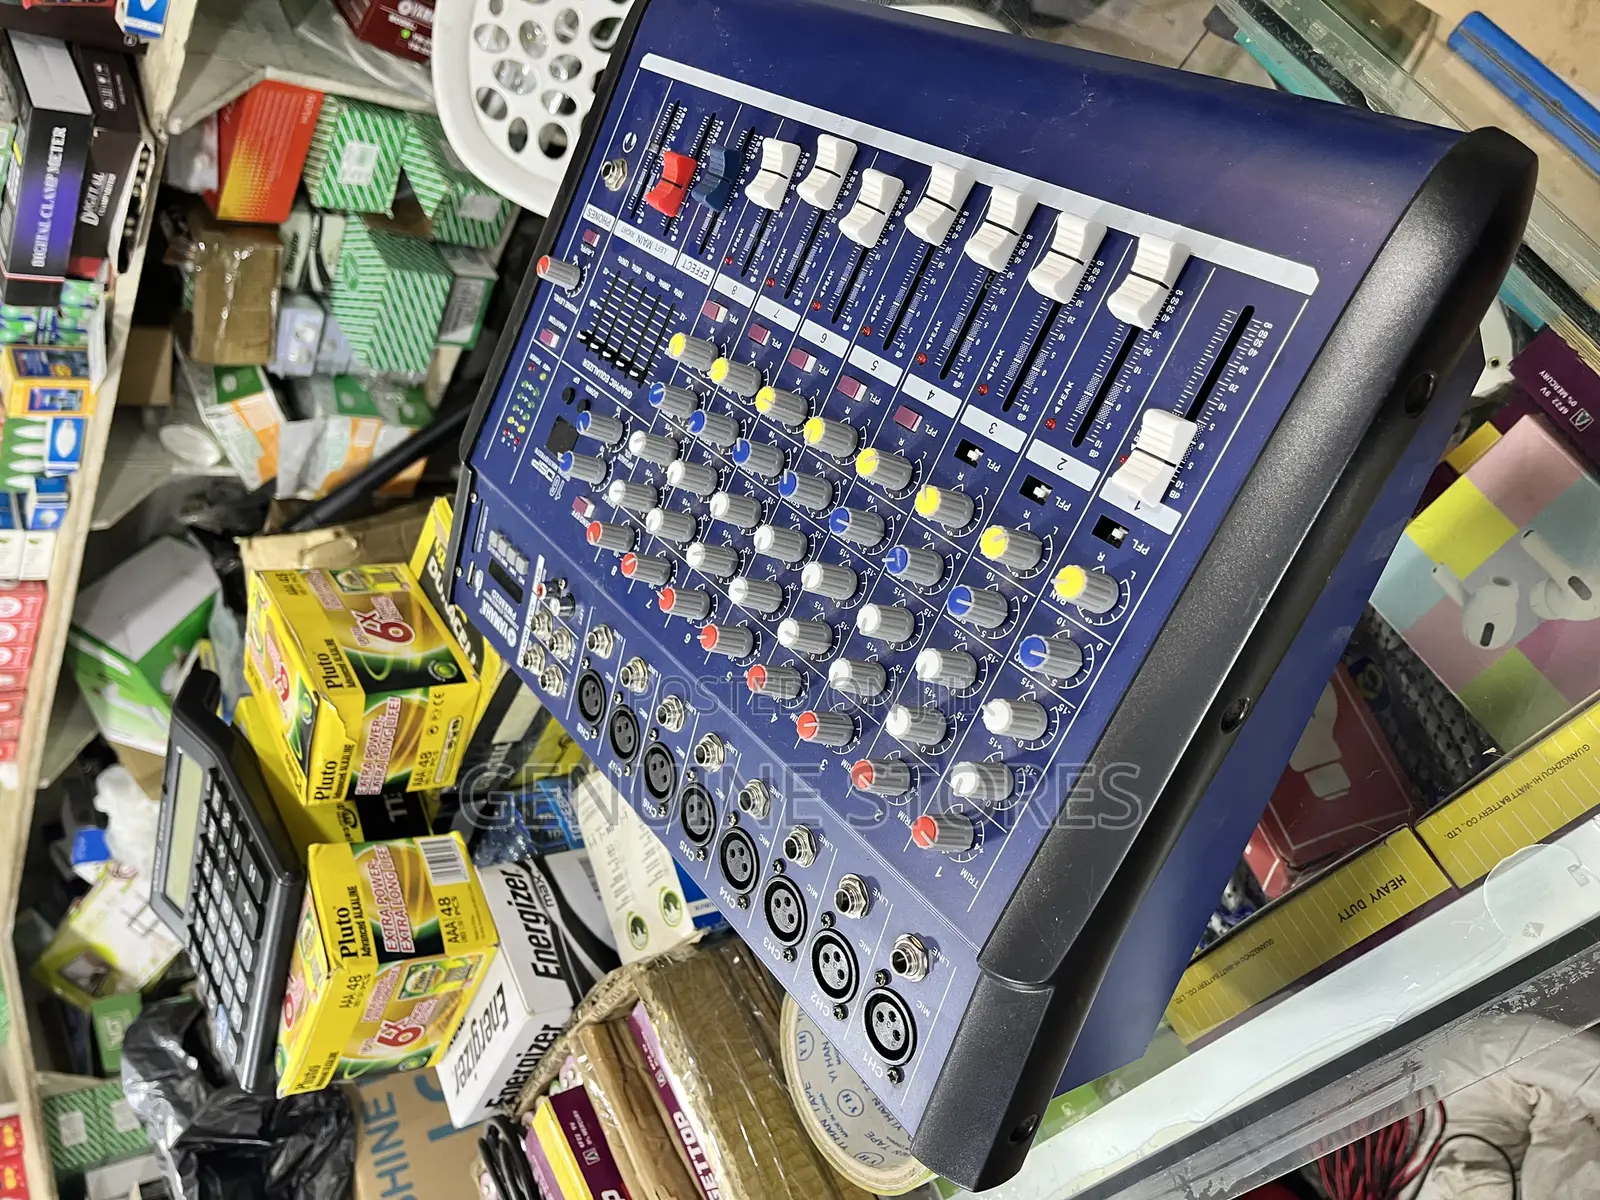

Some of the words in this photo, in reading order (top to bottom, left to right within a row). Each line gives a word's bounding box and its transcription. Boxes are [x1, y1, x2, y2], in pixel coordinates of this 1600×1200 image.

[47, 126, 67, 175] METER
[39, 172, 60, 219] CLAMP
[584, 207, 612, 228] PHONES
[31, 220, 52, 268] DIGITAL
[633, 233, 654, 251] MAIN
[734, 228, 744, 245] PEAK
[776, 248, 787, 268] PEAK
[682, 260, 709, 280] EFFECT
[822, 270, 834, 290] PEAK
[554, 293, 567, 306] LEVEL
[731, 286, 737, 295] 8
[564, 301, 579, 314] PHONE
[774, 309, 780, 318] 7
[873, 294, 886, 315] PEAK
[548, 315, 567, 332] PHANTOM
[928, 321, 942, 343] PEAK
[820, 333, 827, 343] 6
[1253, 338, 1264, 347] 50
[1258, 330, 1268, 339] 60
[990, 349, 1005, 373] PEAK
[1248, 348, 1258, 357] 40
[582, 358, 610, 382] EQUALIZER
[819, 364, 829, 376] PFL
[871, 360, 879, 371] 5
[1238, 366, 1249, 375] 30
[607, 377, 632, 399] GRAPHIC
[1058, 381, 1074, 406] PEAK
[1228, 384, 1239, 393] 20
[1539, 370, 1568, 398] MERCURY
[1540, 387, 1551, 397] 9V
[870, 393, 881, 405] PFL
[927, 390, 935, 400] 4
[1218, 403, 1227, 412] 10
[1552, 399, 1568, 414] 6F22
[925, 424, 938, 437] PFL
[989, 422, 997, 434] 3
[531, 459, 557, 482] DSP
[987, 458, 1001, 472] PFL
[1057, 458, 1067, 470] 2
[1175, 480, 1184, 489] 10
[1056, 496, 1071, 511] PFL
[1169, 490, 1180, 499] dB
[1133, 539, 1150, 555] PFL
[611, 566, 617, 576] 8
[646, 599, 652, 608] 7
[482, 598, 509, 640] YAMAHA
[684, 633, 691, 643] 6
[315, 653, 345, 690] Pluto
[725, 671, 732, 682] 5
[388, 697, 402, 728] LIFE!
[771, 713, 778, 723] 4
[577, 722, 592, 741] CH8
[378, 724, 395, 763] LONG
[608, 760, 622, 778] CH7
[820, 759, 828, 770] 3
[1539, 742, 1591, 779] GUANGZHOU
[314, 760, 339, 801] Pluto
[356, 759, 374, 795] EXTRA
[369, 760, 388, 796] EXTRA
[1509, 774, 1542, 799] HI-WATT
[766, 785, 785, 802] LINE
[642, 798, 657, 818] CH6
[874, 809, 883, 821] 2
[1476, 794, 1511, 820] BATTERY
[897, 810, 914, 829] TRIM
[1460, 814, 1478, 830] CO.,
[759, 834, 770, 848] MIC
[819, 834, 833, 851] LINE
[1443, 825, 1462, 841] LTD.
[679, 840, 694, 861] CH5
[935, 866, 942, 877] 1
[960, 868, 978, 889] TRIM
[385, 871, 403, 909] LONG
[720, 887, 736, 909] CH4
[806, 884, 818, 899] MIC
[872, 887, 892, 907] LINE
[1369, 875, 1406, 903] HEAVY
[348, 885, 365, 921] ALKALINE
[438, 896, 455, 917] 48
[1338, 899, 1367, 923] DUTY
[379, 907, 398, 952] EXTRA
[395, 908, 416, 953] EXTRA
[441, 920, 460, 944] AAA
[501, 868, 566, 980] Energizer
[340, 907, 361, 961] Pluto
[352, 921, 372, 957] Advanced
[763, 937, 782, 960] CH3
[859, 940, 871, 955] MIC
[929, 947, 953, 967] LINE
[1238, 937, 1275, 963] GUANGZHOU
[349, 974, 364, 991] 48
[1194, 972, 1220, 991] BATTERY
[811, 991, 837, 1016] CH2
[916, 1000, 930, 1017] MIC
[454, 980, 509, 1096] Energizer
[856, 1052, 889, 1078] CH1
[822, 1120, 838, 1142] HAN
